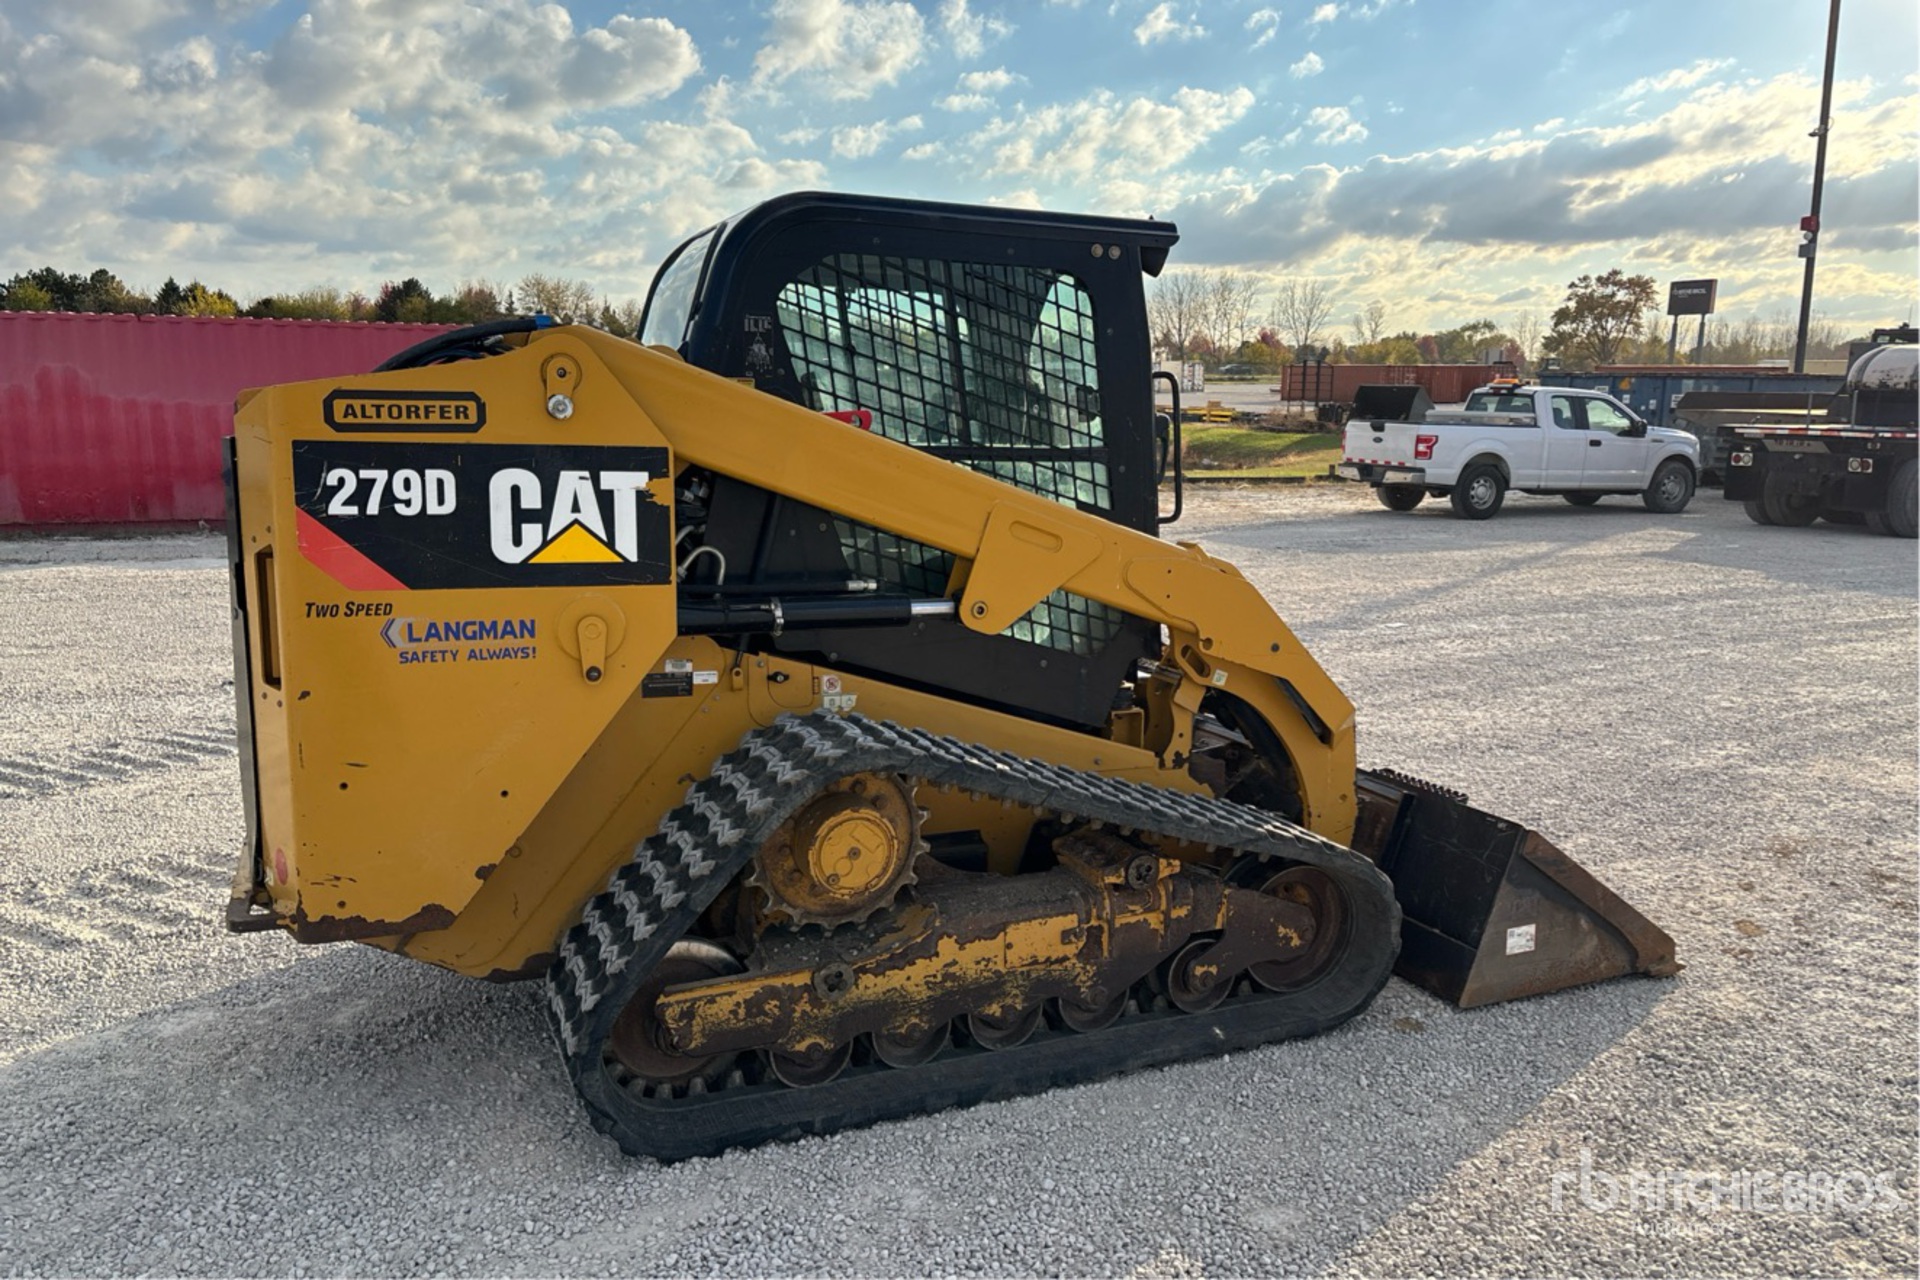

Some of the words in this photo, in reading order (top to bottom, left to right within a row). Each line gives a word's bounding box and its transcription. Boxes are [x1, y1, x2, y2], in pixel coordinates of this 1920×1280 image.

[342, 403, 471, 420] ALTORFER
[325, 468, 457, 516] 279D
[488, 468, 649, 564] CAT
[406, 619, 537, 642] LANGMAN
[398, 649, 458, 664] SAFETY
[466, 646, 538, 662] ALWAYS!
